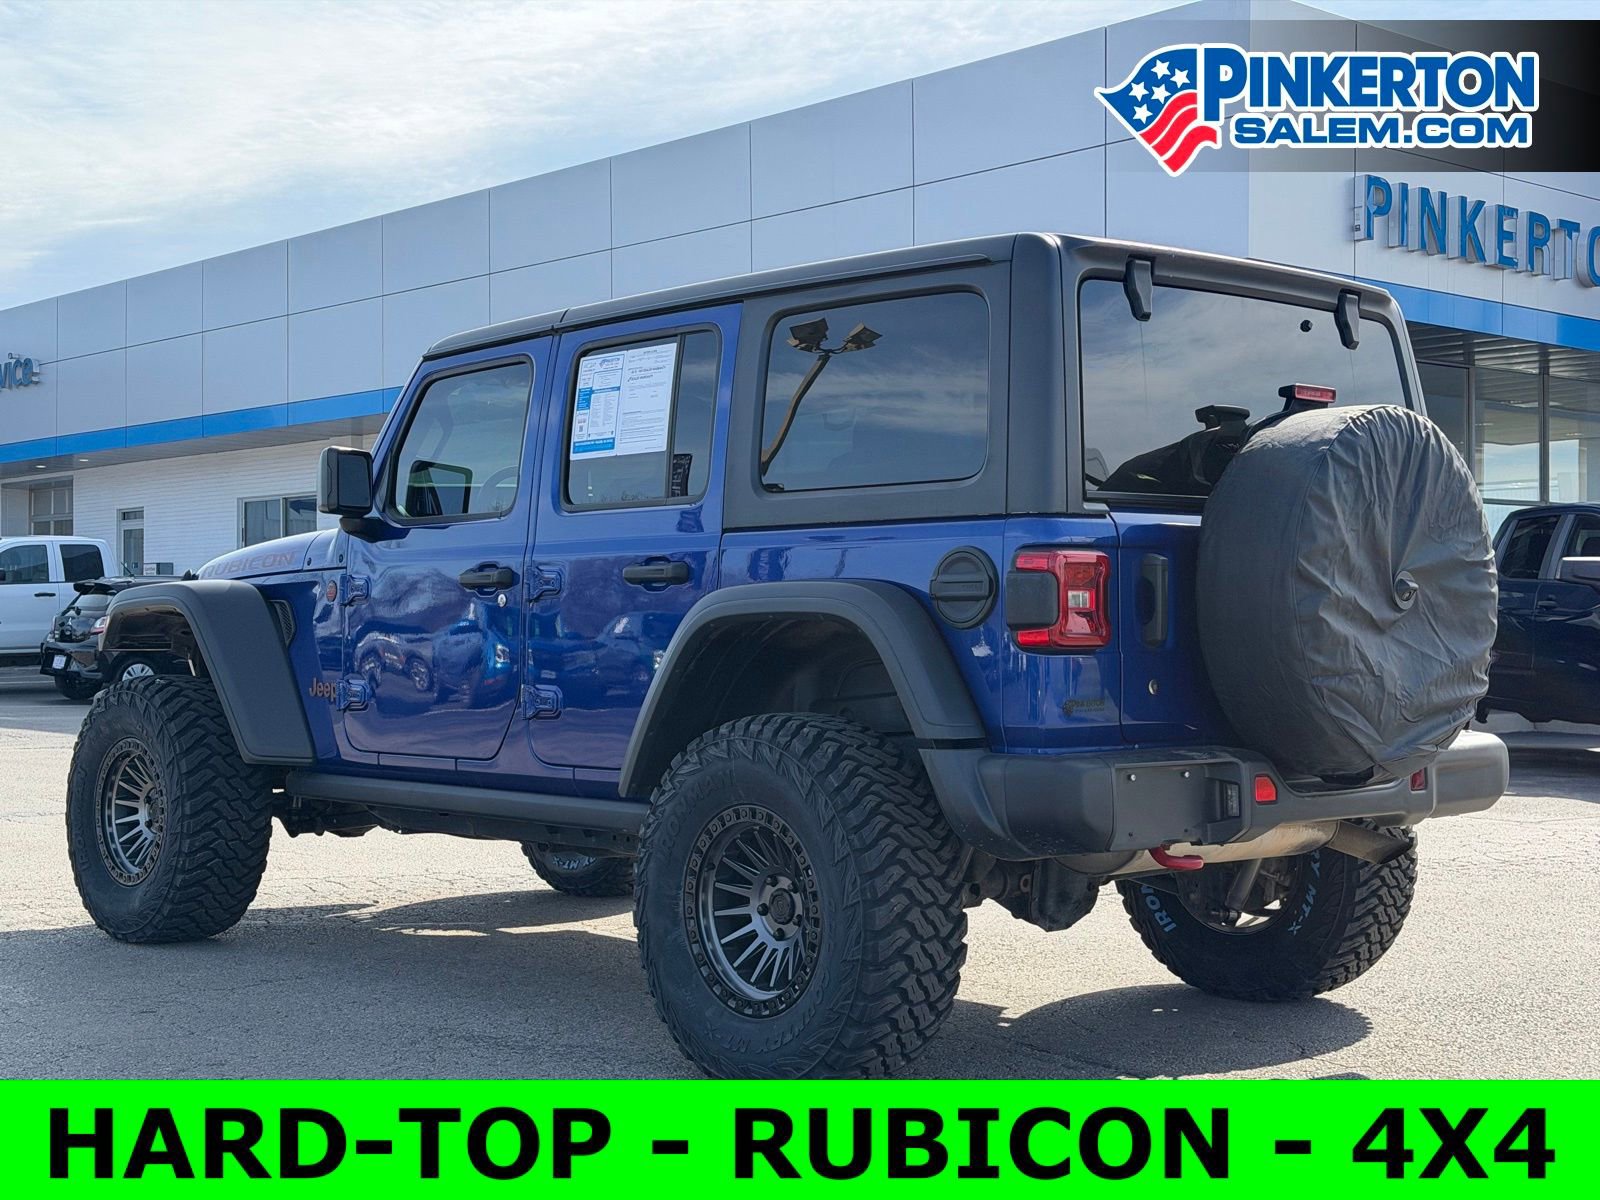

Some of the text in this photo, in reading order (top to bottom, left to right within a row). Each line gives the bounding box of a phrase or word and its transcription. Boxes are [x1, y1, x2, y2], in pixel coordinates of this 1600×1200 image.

[201, 550, 298, 580] RUBICON
[309, 678, 337, 706] Jeep
[1287, 884, 1317, 936] MT-X
